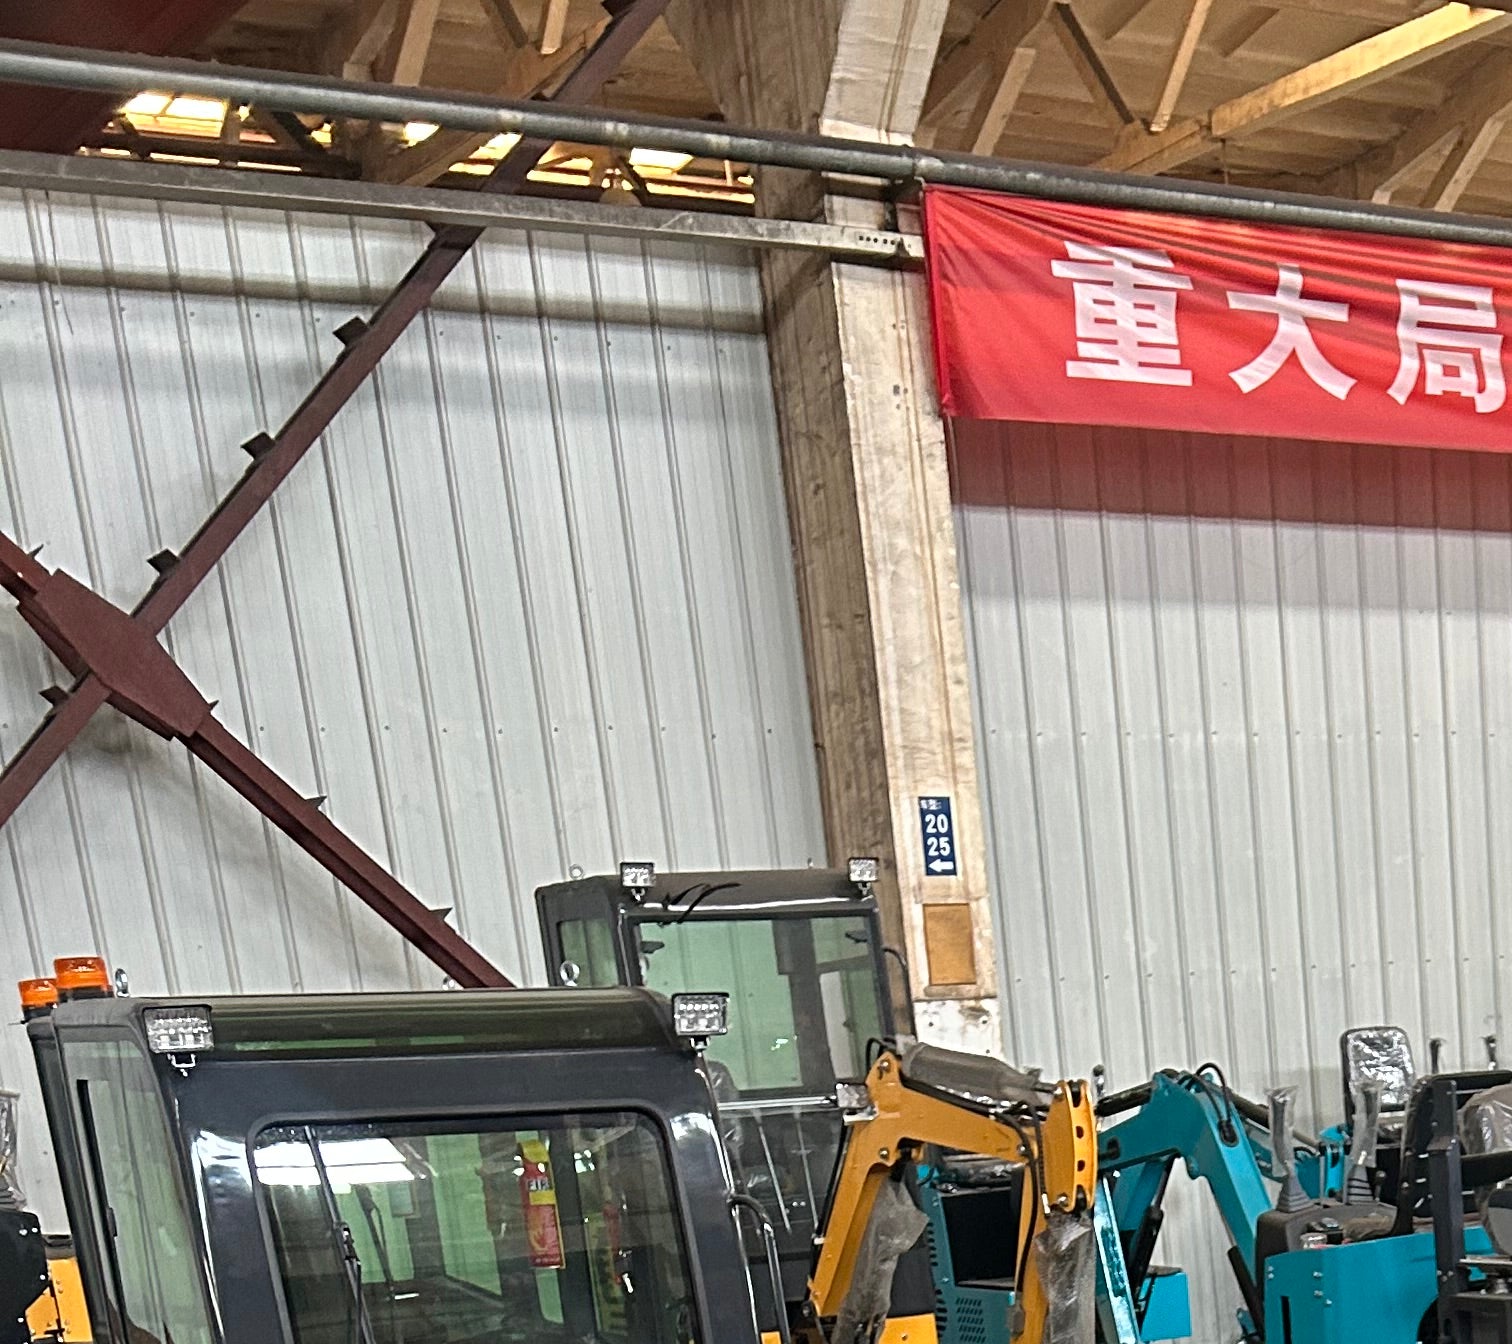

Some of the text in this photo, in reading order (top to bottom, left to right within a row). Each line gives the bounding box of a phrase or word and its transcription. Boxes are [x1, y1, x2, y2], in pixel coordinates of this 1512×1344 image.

[1050, 240, 1508, 414] 重大局
[925, 814, 948, 833] 20
[927, 837, 950, 856] 25
